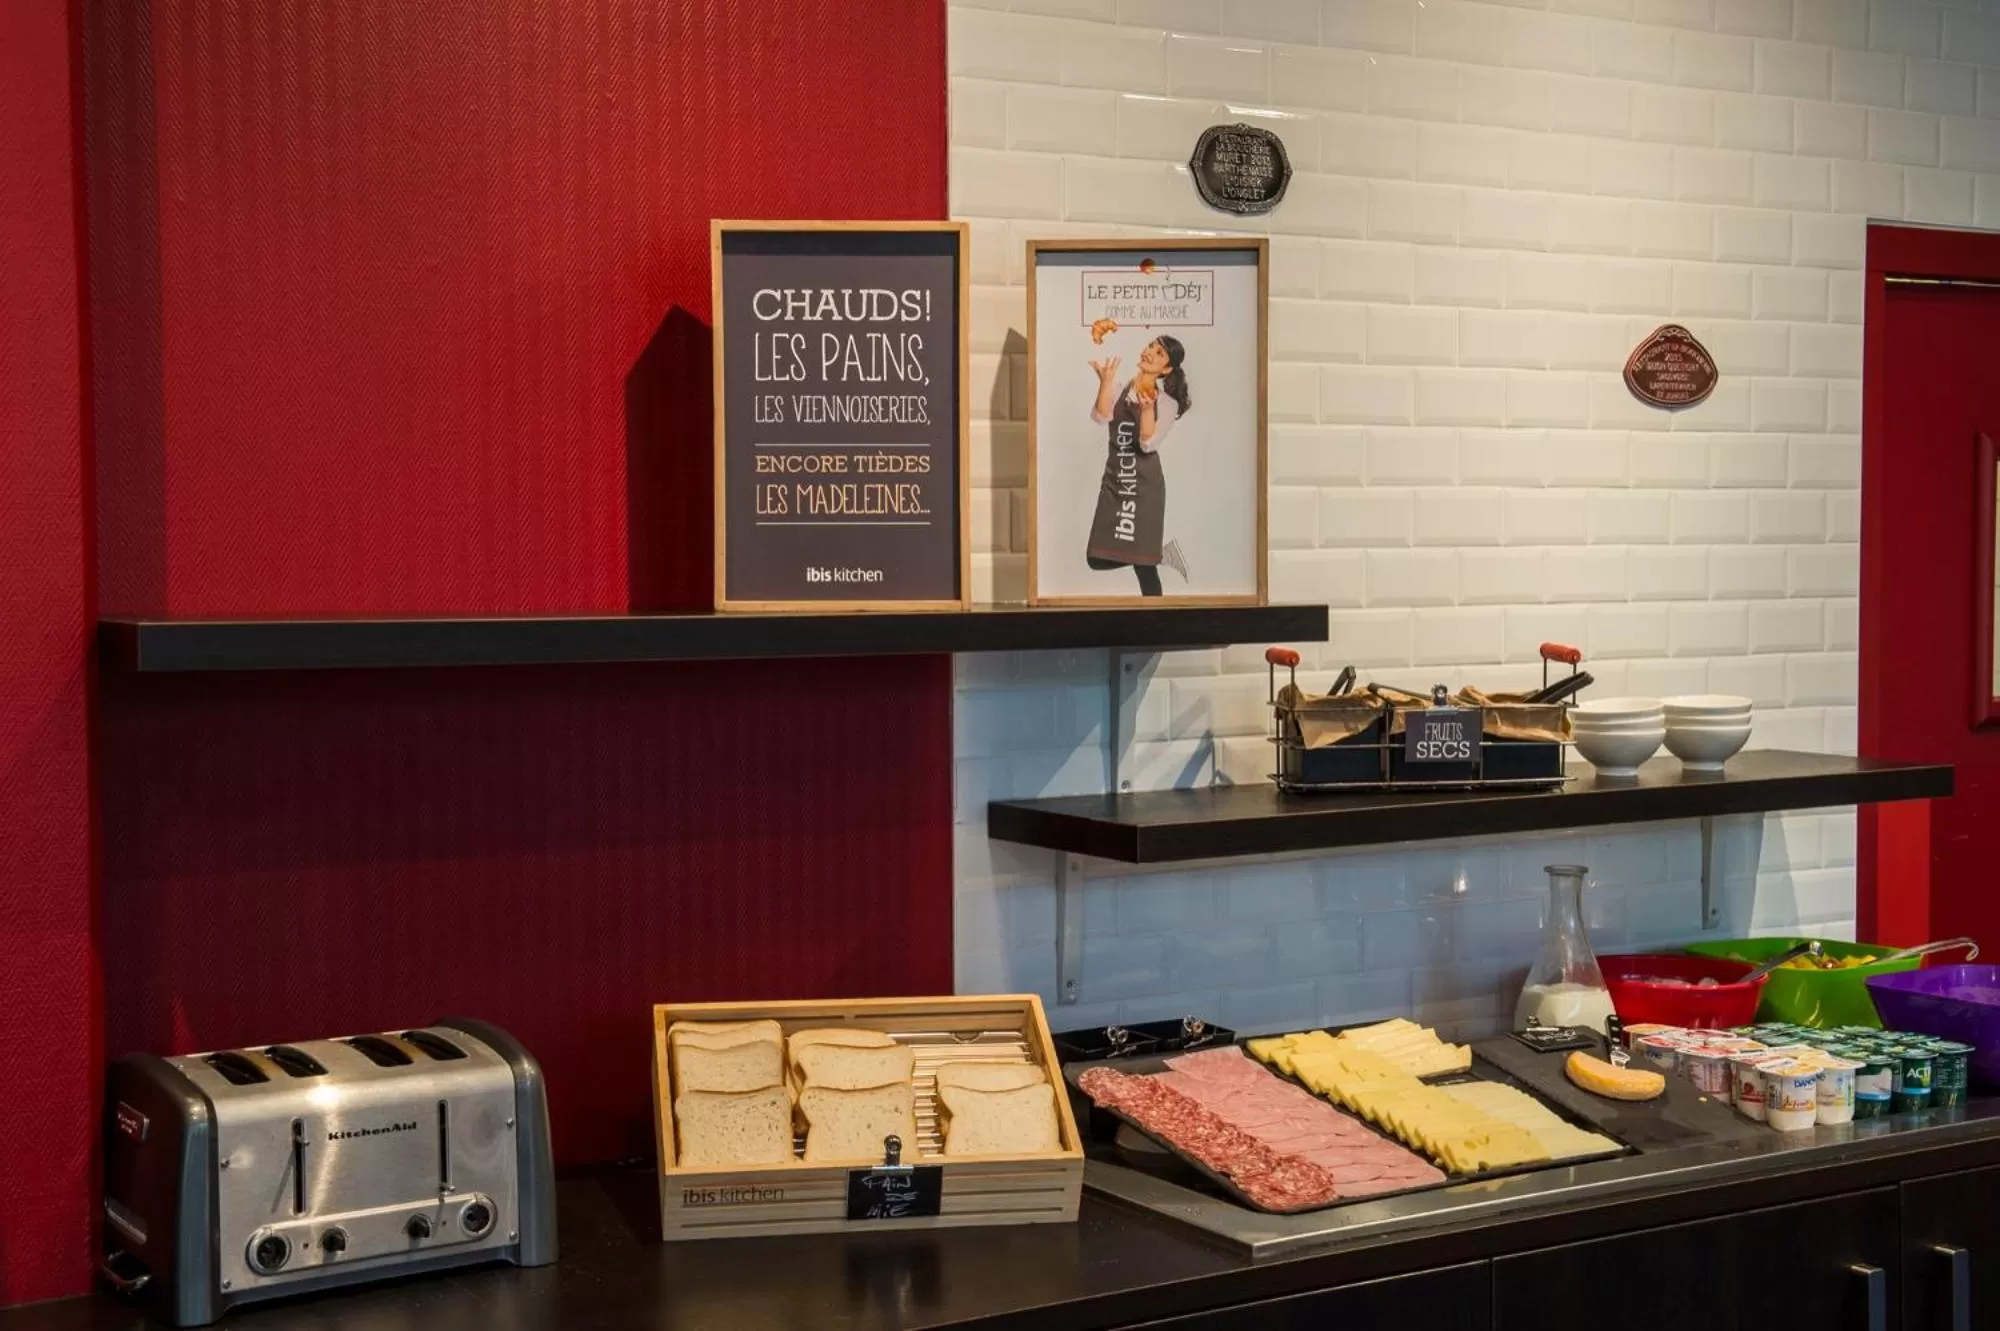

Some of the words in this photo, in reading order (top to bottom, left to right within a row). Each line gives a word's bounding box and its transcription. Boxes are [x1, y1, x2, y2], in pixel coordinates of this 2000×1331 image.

[1215, 150, 1248, 164] MURET
[1087, 285, 1108, 300] LE
[1112, 285, 1159, 300] PETIT
[752, 288, 931, 322] CHAUDS!
[754, 332, 807, 382] LES
[821, 332, 930, 386] PAINS,
[755, 394, 784, 423] LES
[791, 394, 931, 426] VIENNOISERIES,
[755, 455, 848, 473] ENCORE
[854, 449, 930, 473] TIÈDES
[1116, 421, 1137, 496] kitchen
[756, 484, 788, 514] LES
[1114, 500, 1136, 542] ibis
[806, 566, 832, 583] ibis
[833, 566, 884, 583] kitchen
[1424, 721, 1464, 741] FRUITS
[1416, 741, 1471, 759] SECS
[328, 1121, 417, 1141] KitchenAid
[683, 1188, 717, 1205] ibis
[719, 1186, 785, 1204] kitchen
